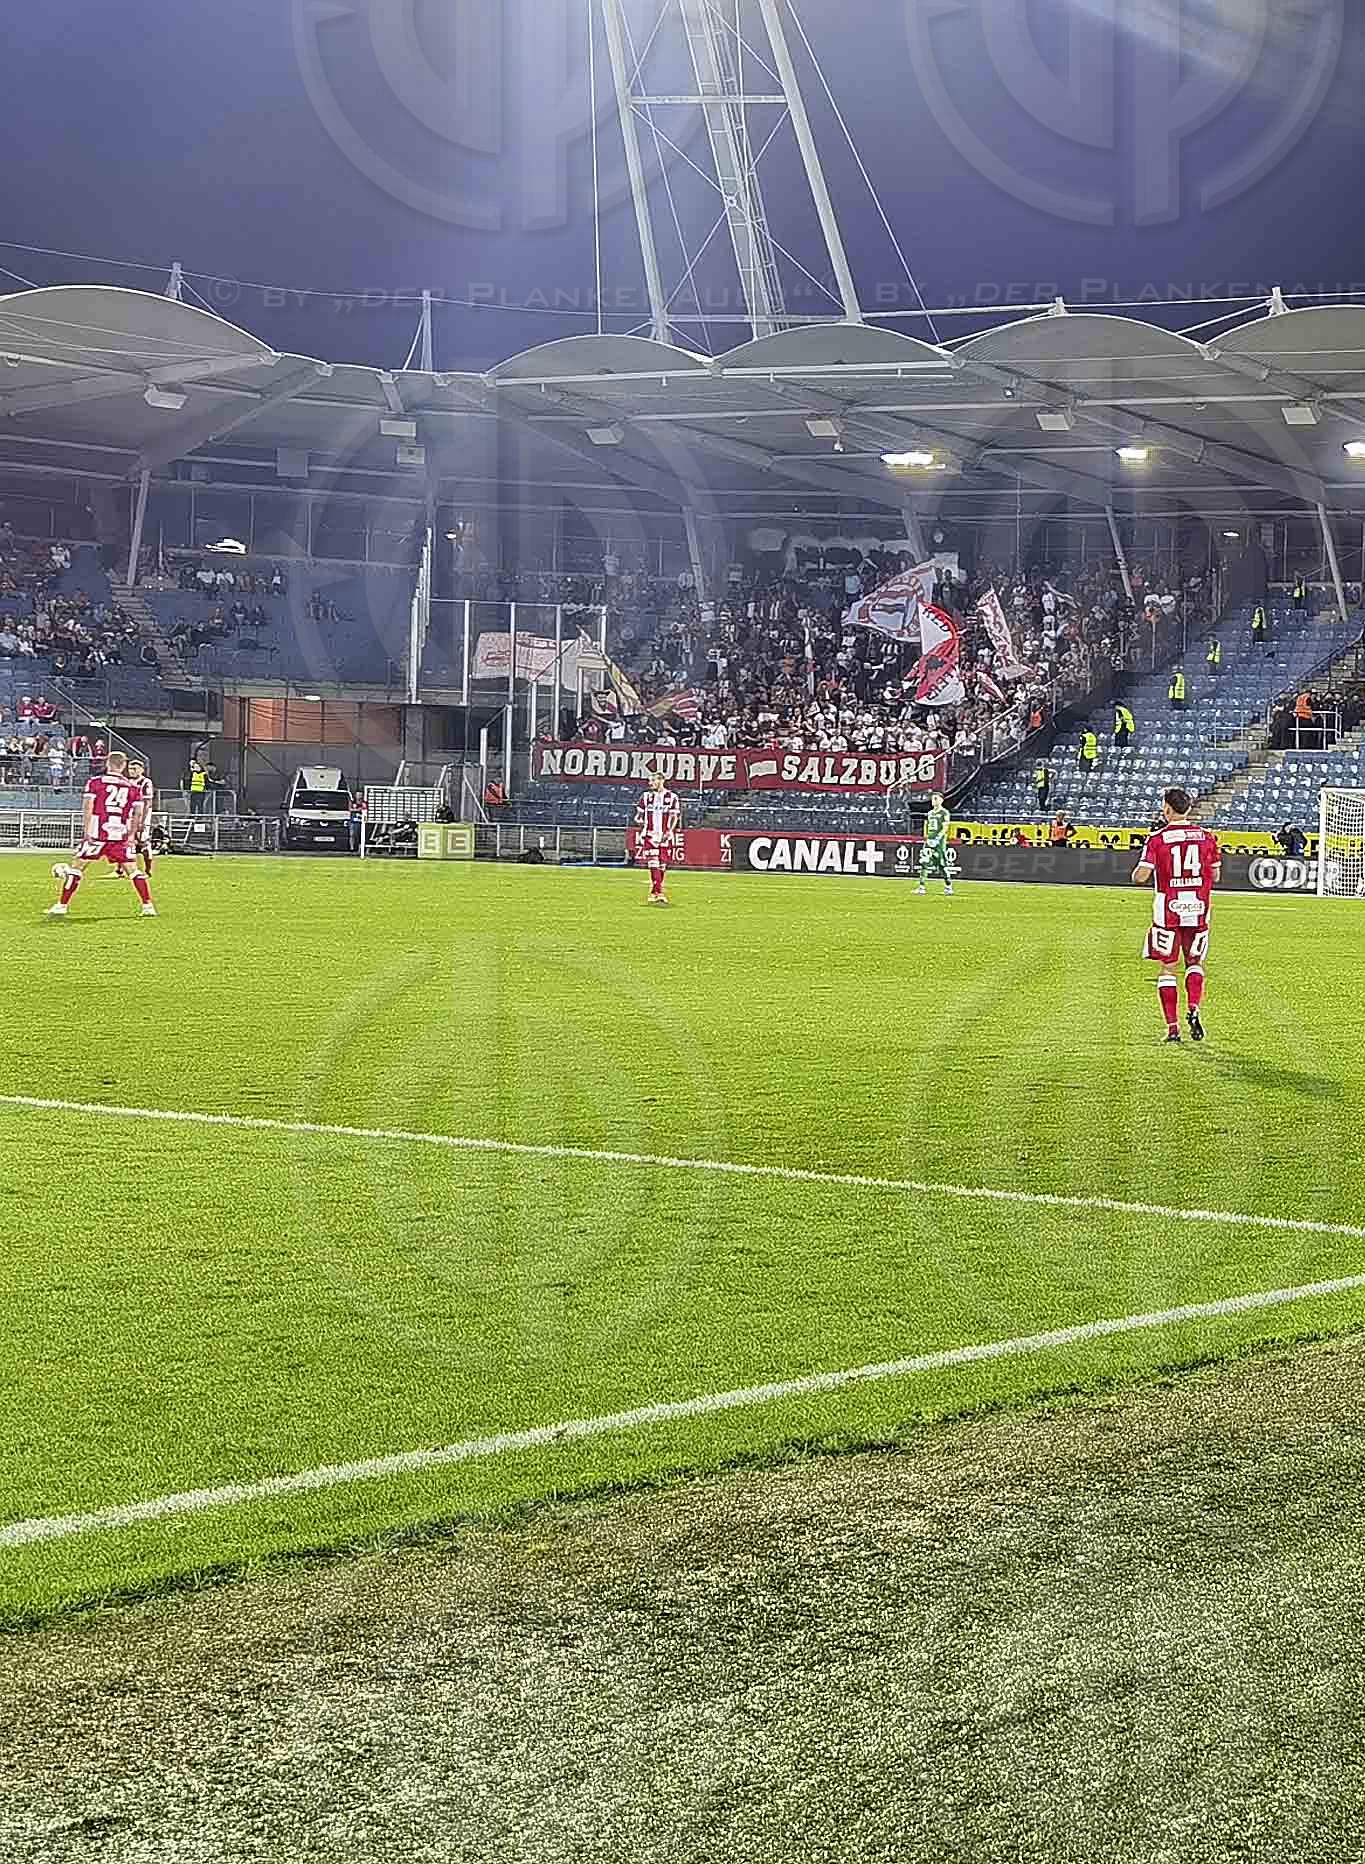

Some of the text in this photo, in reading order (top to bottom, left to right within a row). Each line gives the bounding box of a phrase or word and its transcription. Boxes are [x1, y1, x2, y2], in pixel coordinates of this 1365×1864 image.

[541, 749, 937, 786] NORDKURVE SALZBURG
[105, 785, 129, 808] 24
[749, 837, 884, 873] CANAL+
[1171, 844, 1202, 877] 14
